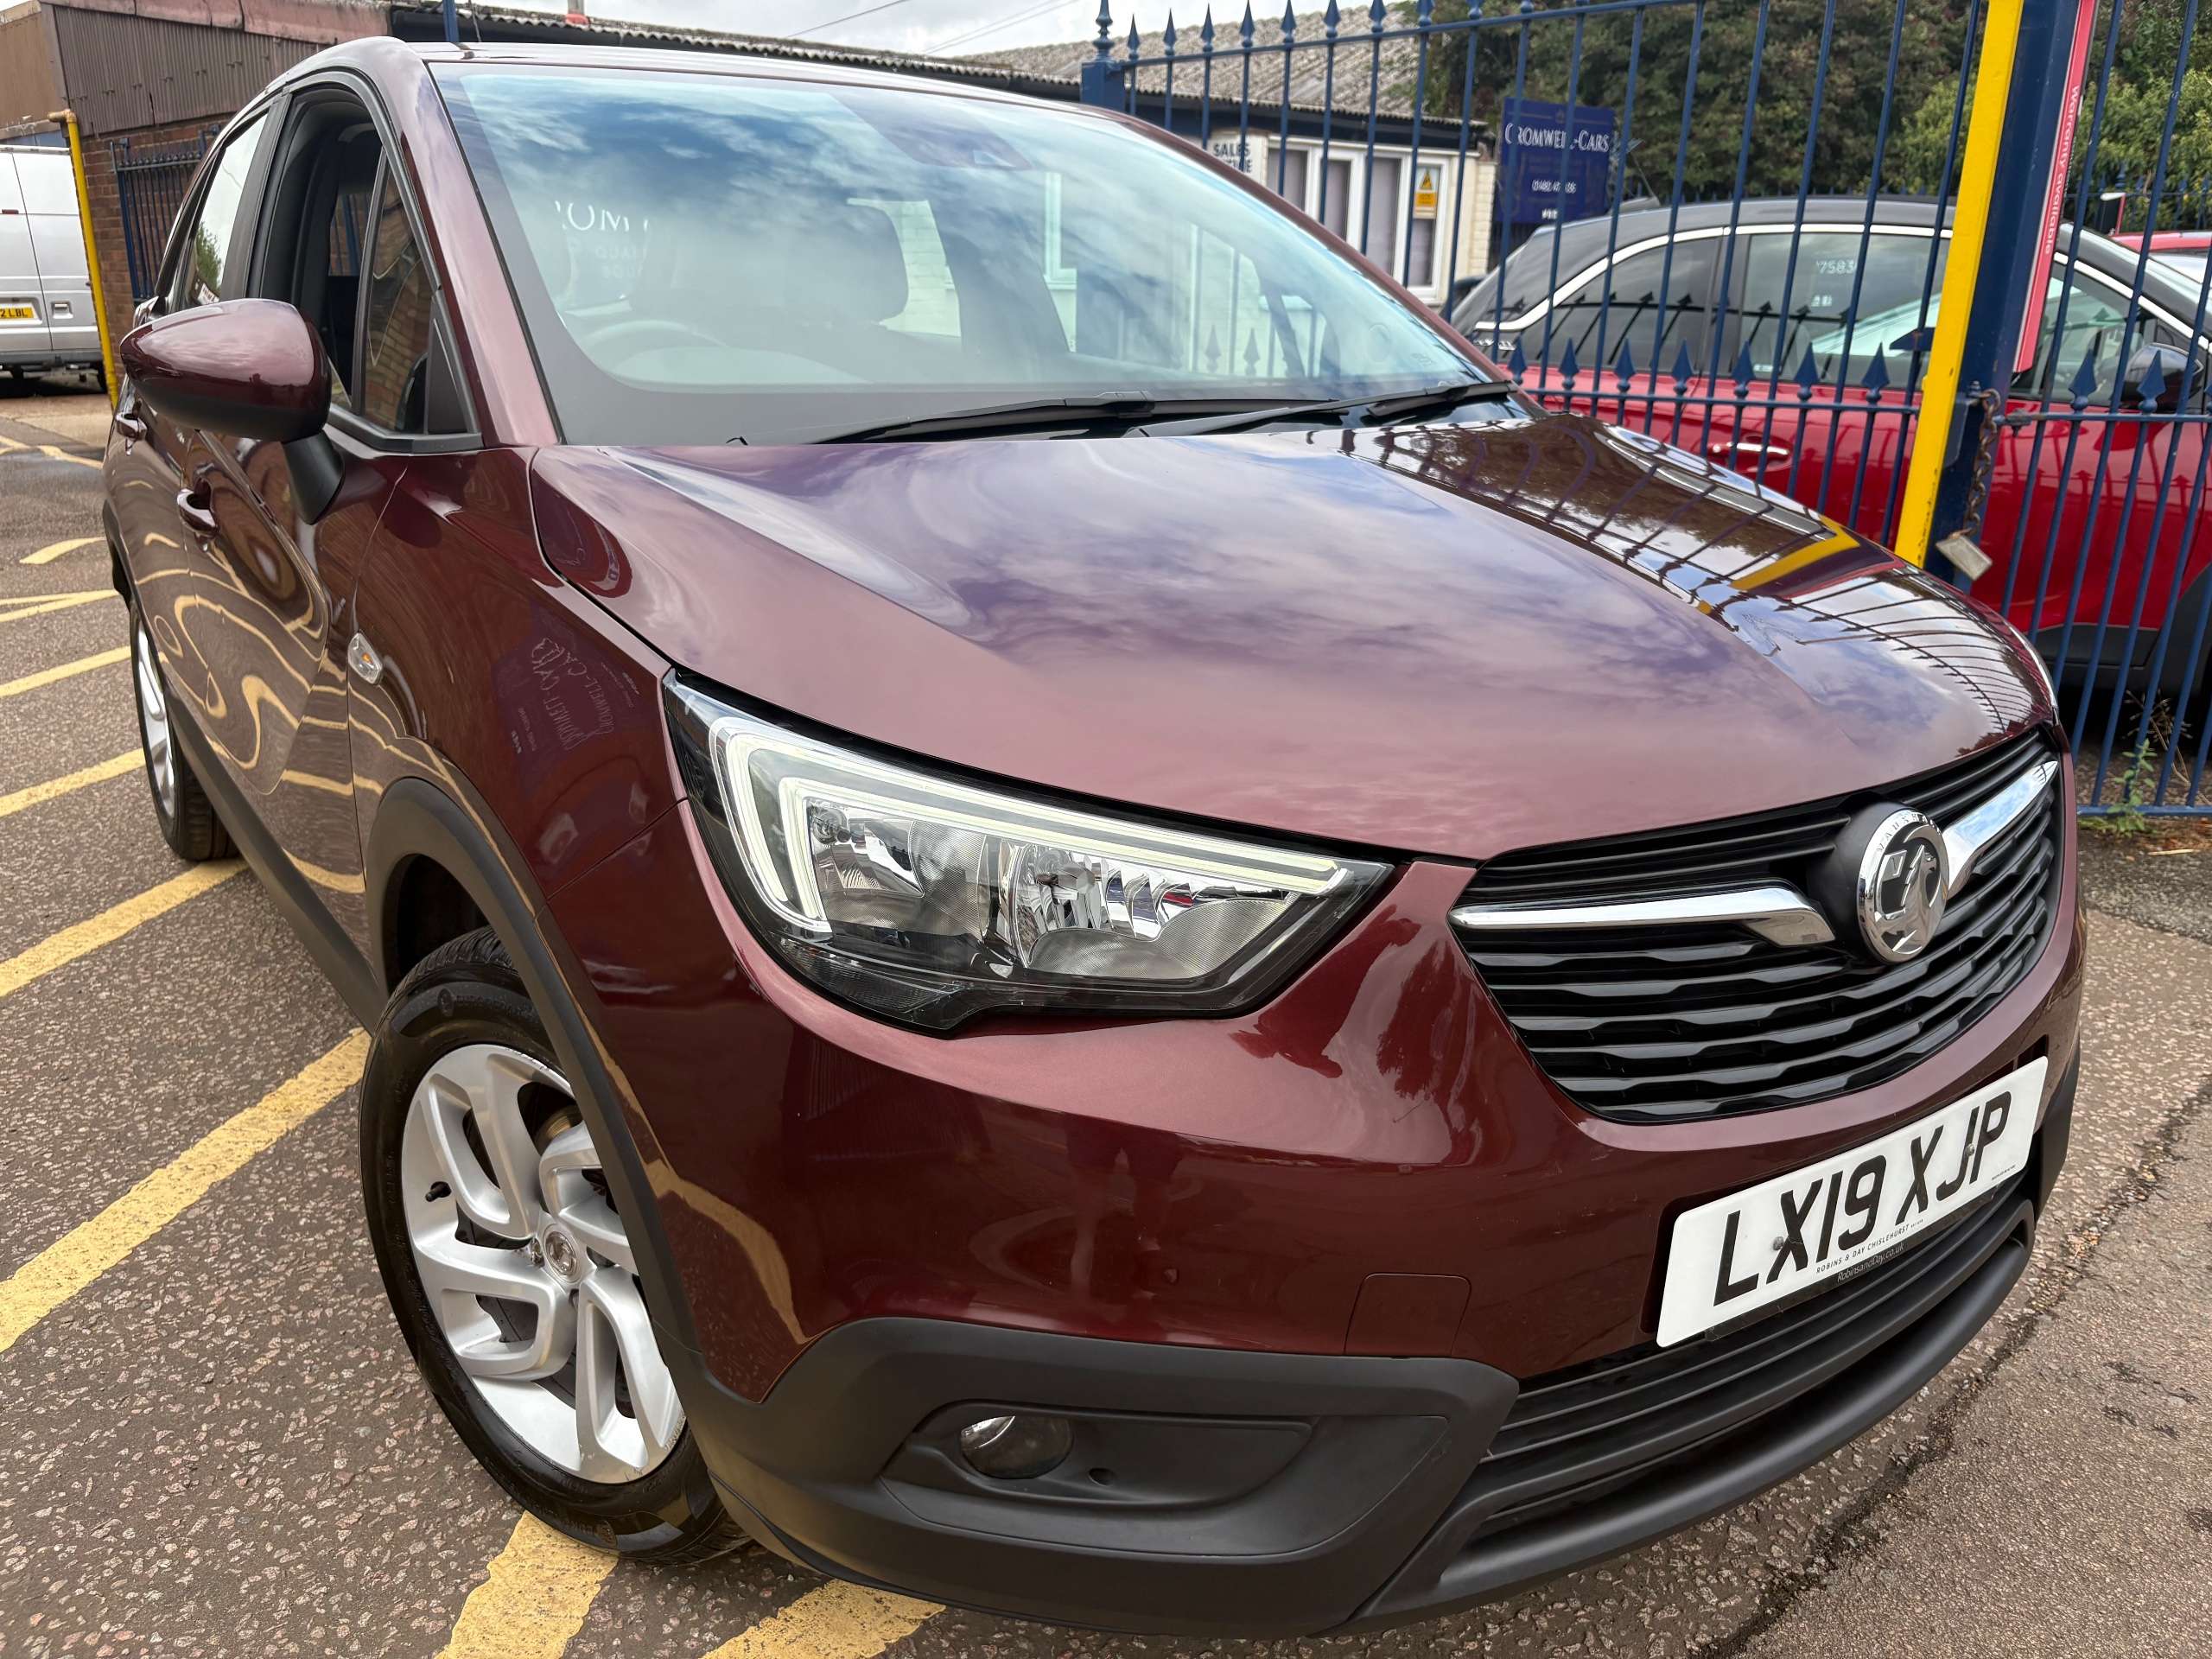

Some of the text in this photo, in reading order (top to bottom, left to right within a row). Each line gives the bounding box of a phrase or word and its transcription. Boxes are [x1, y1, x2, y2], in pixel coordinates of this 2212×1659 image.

[1713, 1090, 2012, 1307] LX19 XJP
[1815, 1257, 1843, 1274] ROBINS
[1852, 1247, 1866, 1258] DAY
[1867, 1224, 1910, 1250] CHISLEHURST
